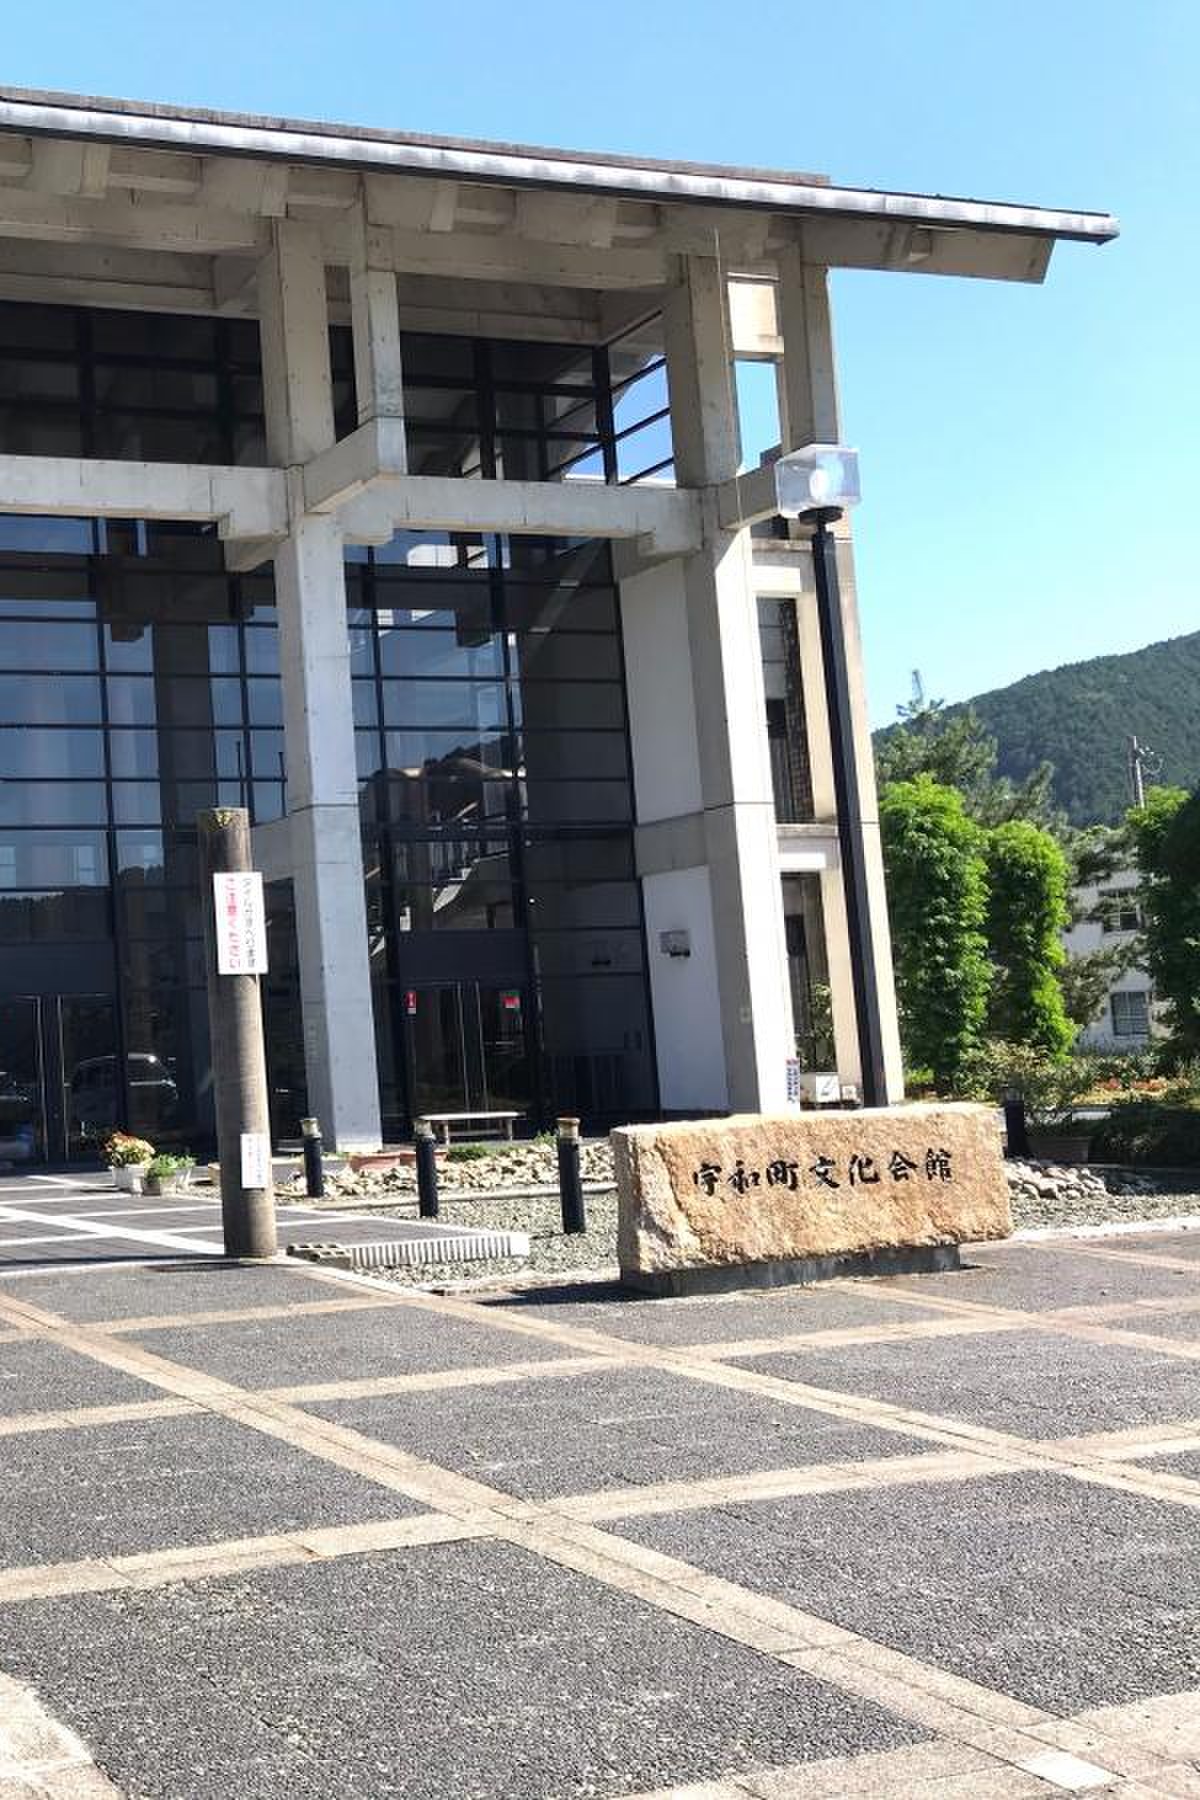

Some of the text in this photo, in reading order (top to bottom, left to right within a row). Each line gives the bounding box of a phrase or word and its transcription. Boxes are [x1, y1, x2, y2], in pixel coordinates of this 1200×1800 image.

[693, 1148, 952, 1196] 宇和町文化会館
